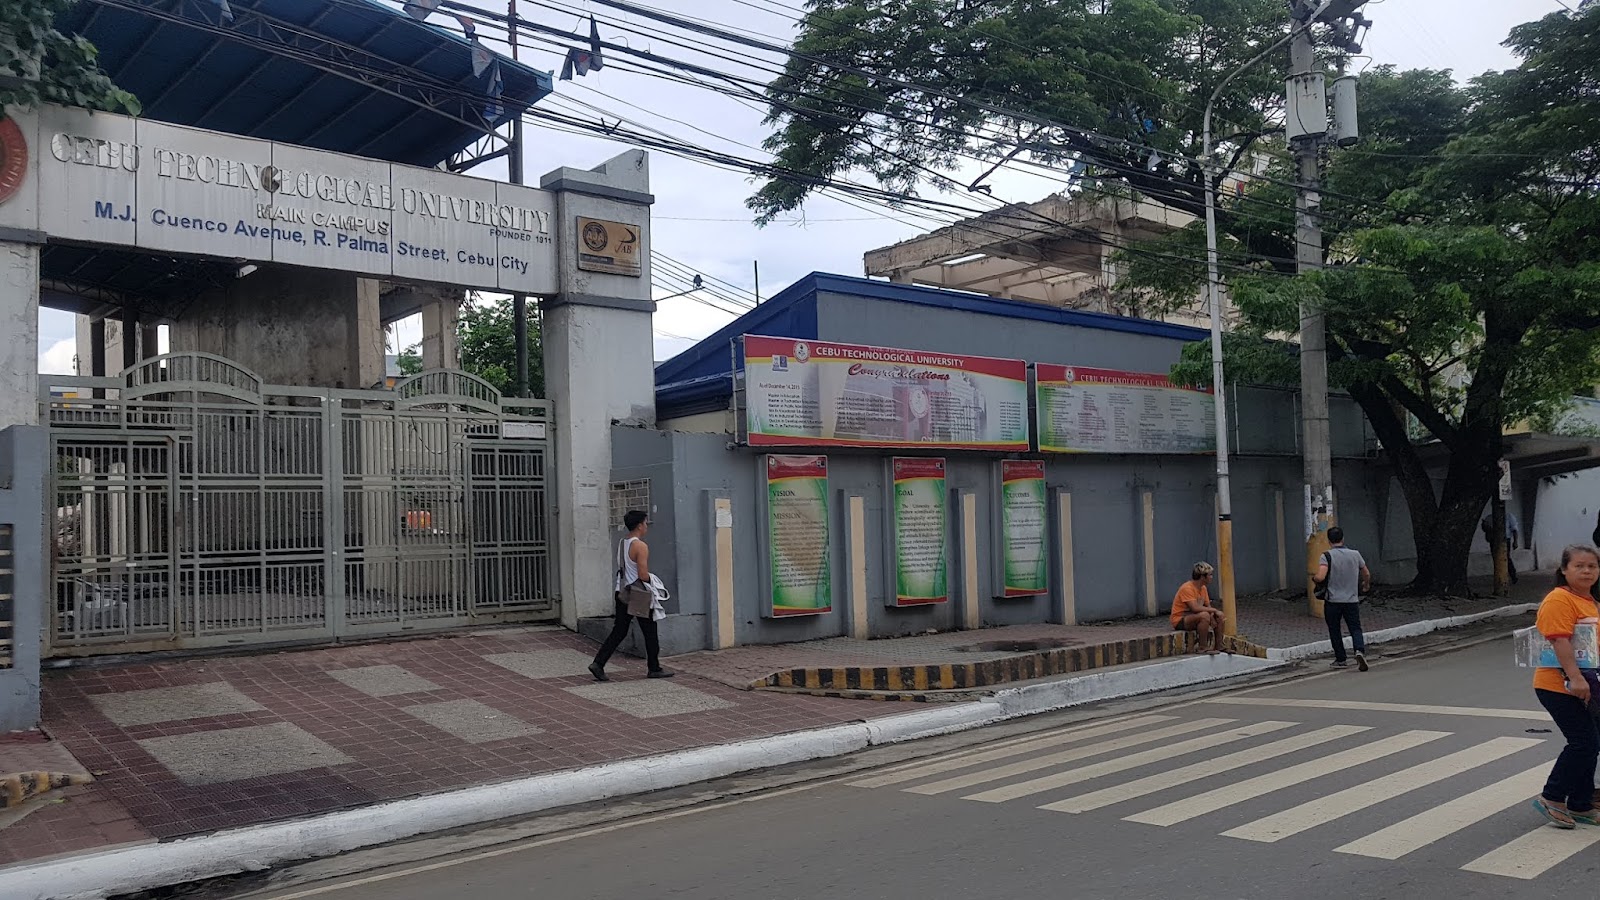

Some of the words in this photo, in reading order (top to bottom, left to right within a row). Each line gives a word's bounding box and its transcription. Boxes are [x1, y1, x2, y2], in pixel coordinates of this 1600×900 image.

[51, 133, 142, 173] CEBU
[154, 147, 396, 211] TECHNOLOGICAL
[401, 188, 550, 234] UNIVERSITY
[256, 203, 306, 225] MAIN
[312, 211, 390, 236] CAMPUS
[95, 201, 137, 222] M.J.
[152, 208, 228, 233] Cuenco
[234, 220, 306, 246] Avenue,
[313, 229, 331, 247] R.
[337, 234, 389, 254] Palma
[397, 241, 450, 264] Street,
[457, 250, 494, 267] Cebu
[501, 256, 529, 275] City
[489, 229, 532, 242] FOUNDED
[535, 236, 552, 244] 1911
[815, 346, 841, 357] CEBU
[842, 349, 915, 363] TECHNOLOGICAL
[917, 356, 965, 368] UNIVERSITY
[847, 363, 951, 381] Congratulations
[1080, 374, 1098, 382] CEBU
[1100, 375, 1154, 387] TECHNOLOGICAL
[773, 512, 801, 520] MISSION
